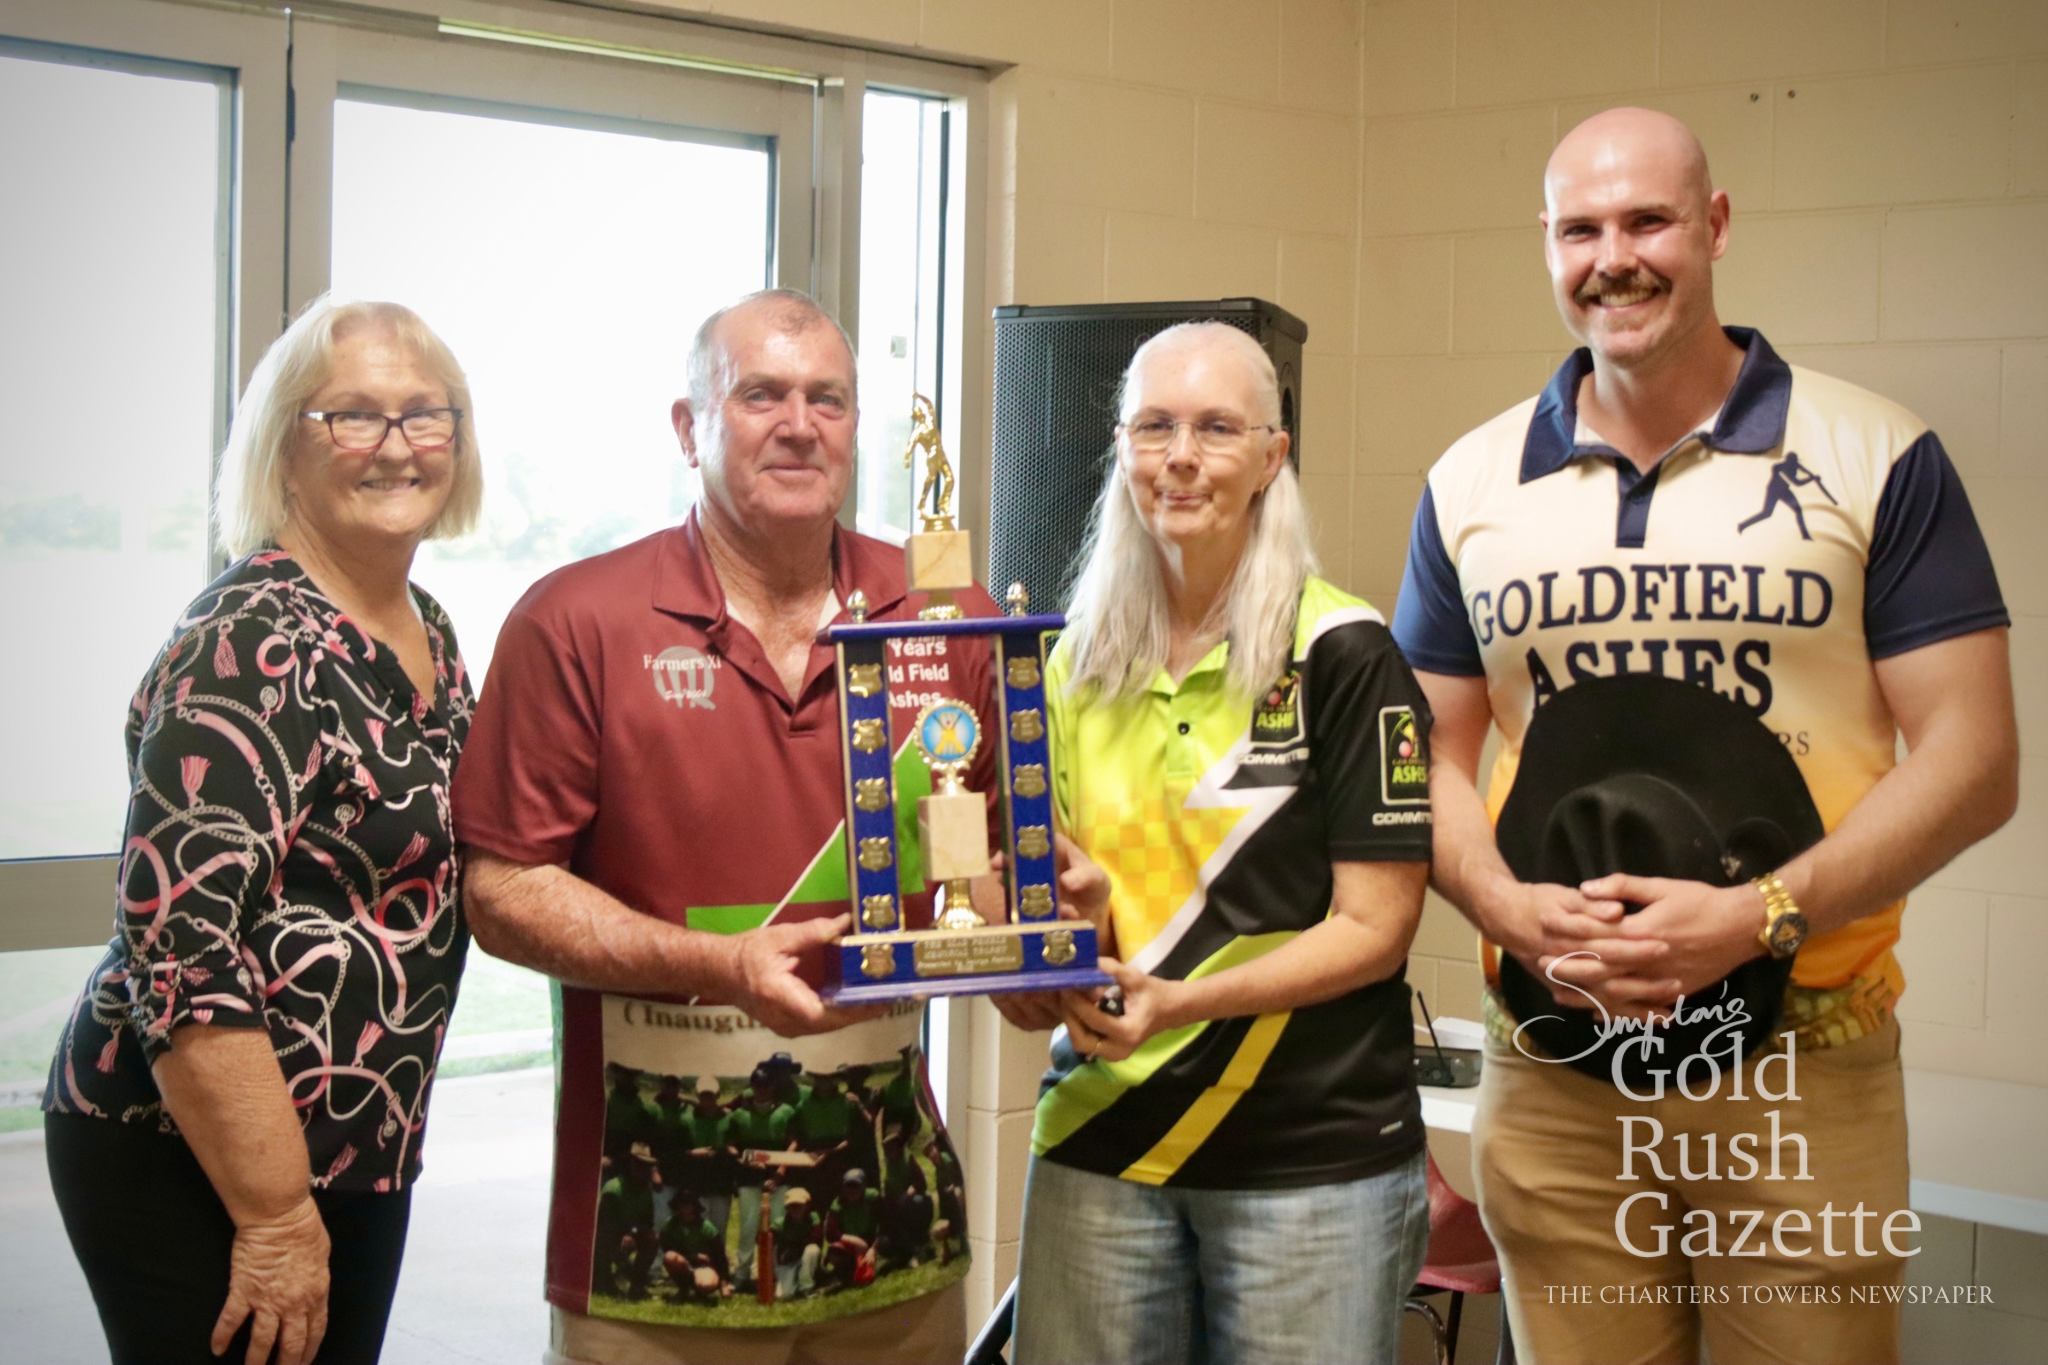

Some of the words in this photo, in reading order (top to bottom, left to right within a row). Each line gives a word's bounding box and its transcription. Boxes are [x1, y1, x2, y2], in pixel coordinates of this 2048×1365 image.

[1472, 564, 1833, 646] GOLDFIELD
[891, 640, 947, 657] Years
[643, 654, 704, 671] Farmers
[707, 654, 722, 669] XI
[887, 664, 904, 683] ld
[908, 663, 949, 682] Field
